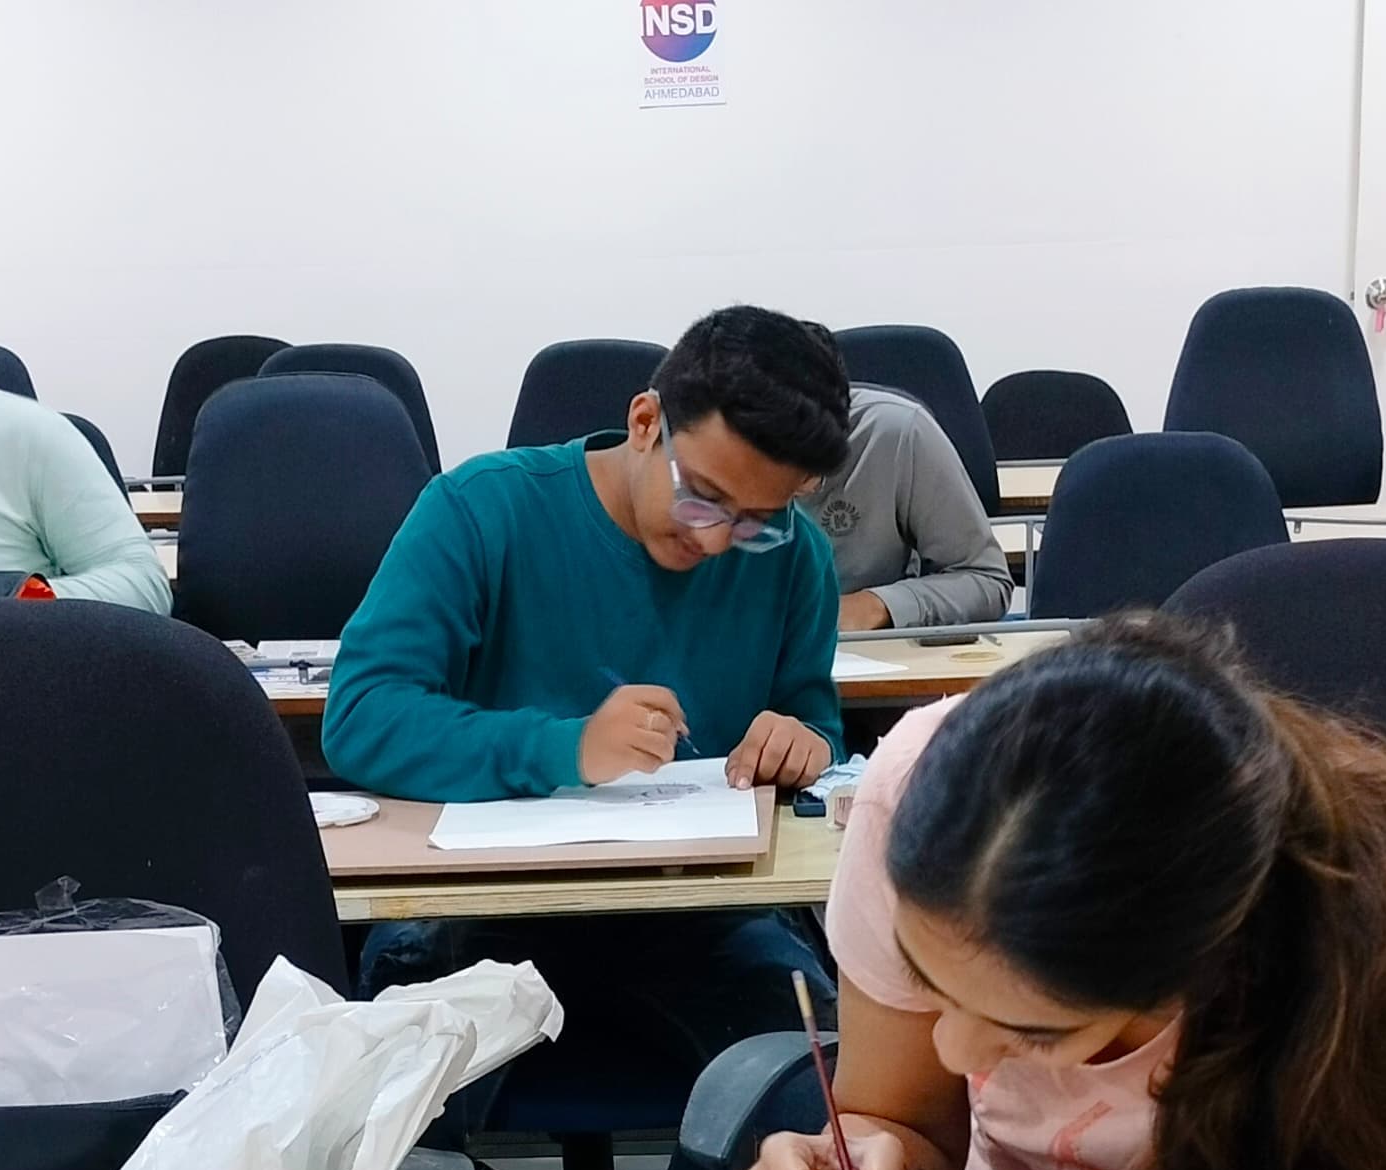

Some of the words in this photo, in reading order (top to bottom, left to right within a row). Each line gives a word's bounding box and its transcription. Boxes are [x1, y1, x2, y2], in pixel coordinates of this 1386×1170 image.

[651, 66, 711, 75] INTERNATIONAL
[645, 76, 676, 85] SCHOOL
[690, 74, 719, 82] DESIGN
[644, 86, 720, 100] AHMEDABAD
